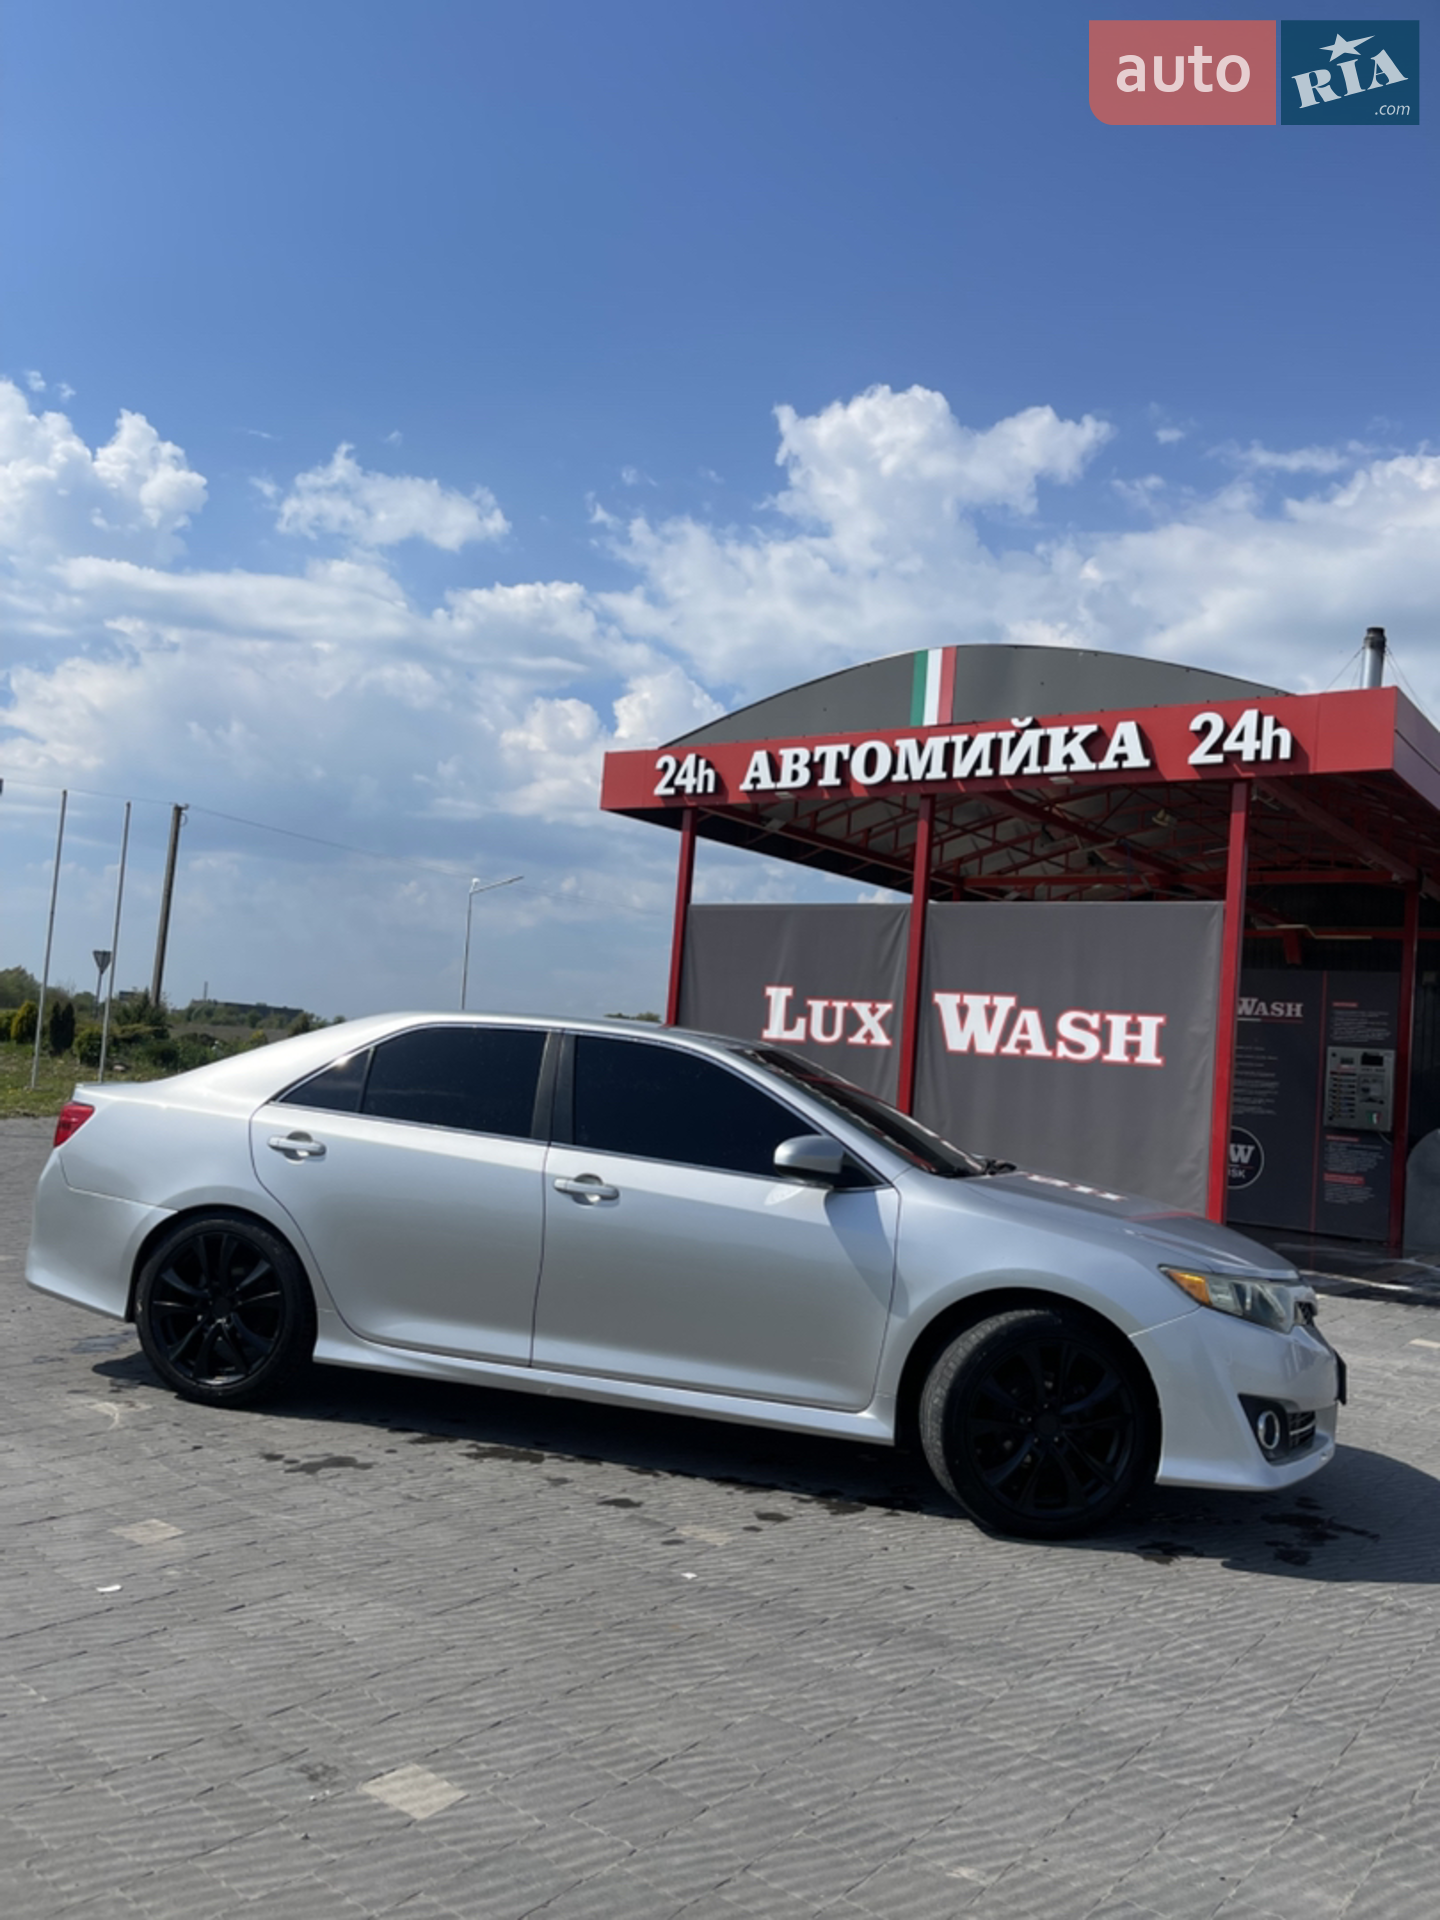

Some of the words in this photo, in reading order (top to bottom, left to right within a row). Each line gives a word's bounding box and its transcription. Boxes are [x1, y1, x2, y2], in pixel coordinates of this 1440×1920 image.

[653, 753, 717, 797] 24h
[739, 717, 1151, 792] АВТОМИЙКА
[1187, 708, 1293, 766] 24h
